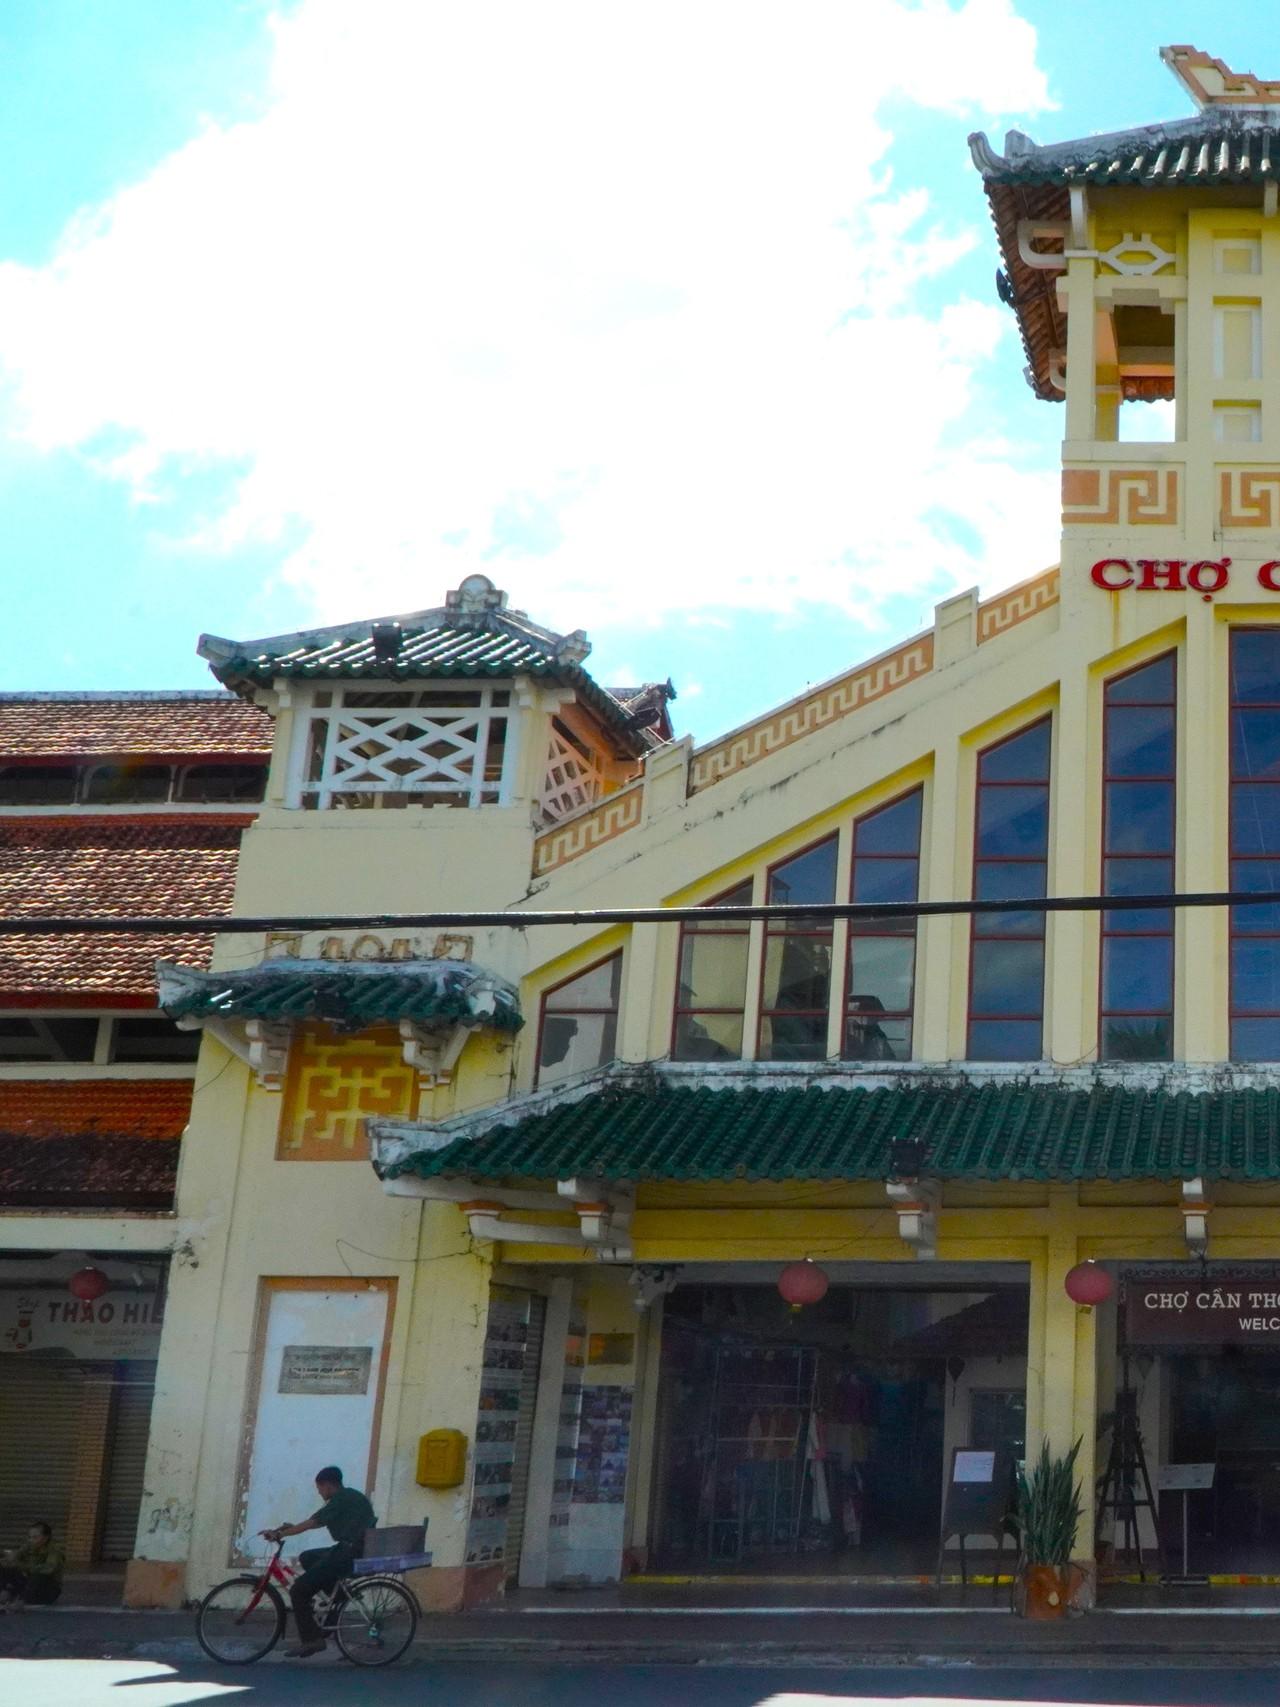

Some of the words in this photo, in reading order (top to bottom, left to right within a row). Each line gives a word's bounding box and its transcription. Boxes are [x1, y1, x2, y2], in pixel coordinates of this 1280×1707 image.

[1090, 557, 1231, 602] CHỢ
[1144, 1291, 1190, 1313] CHỢ
[1196, 1287, 1241, 1309] CẦN
